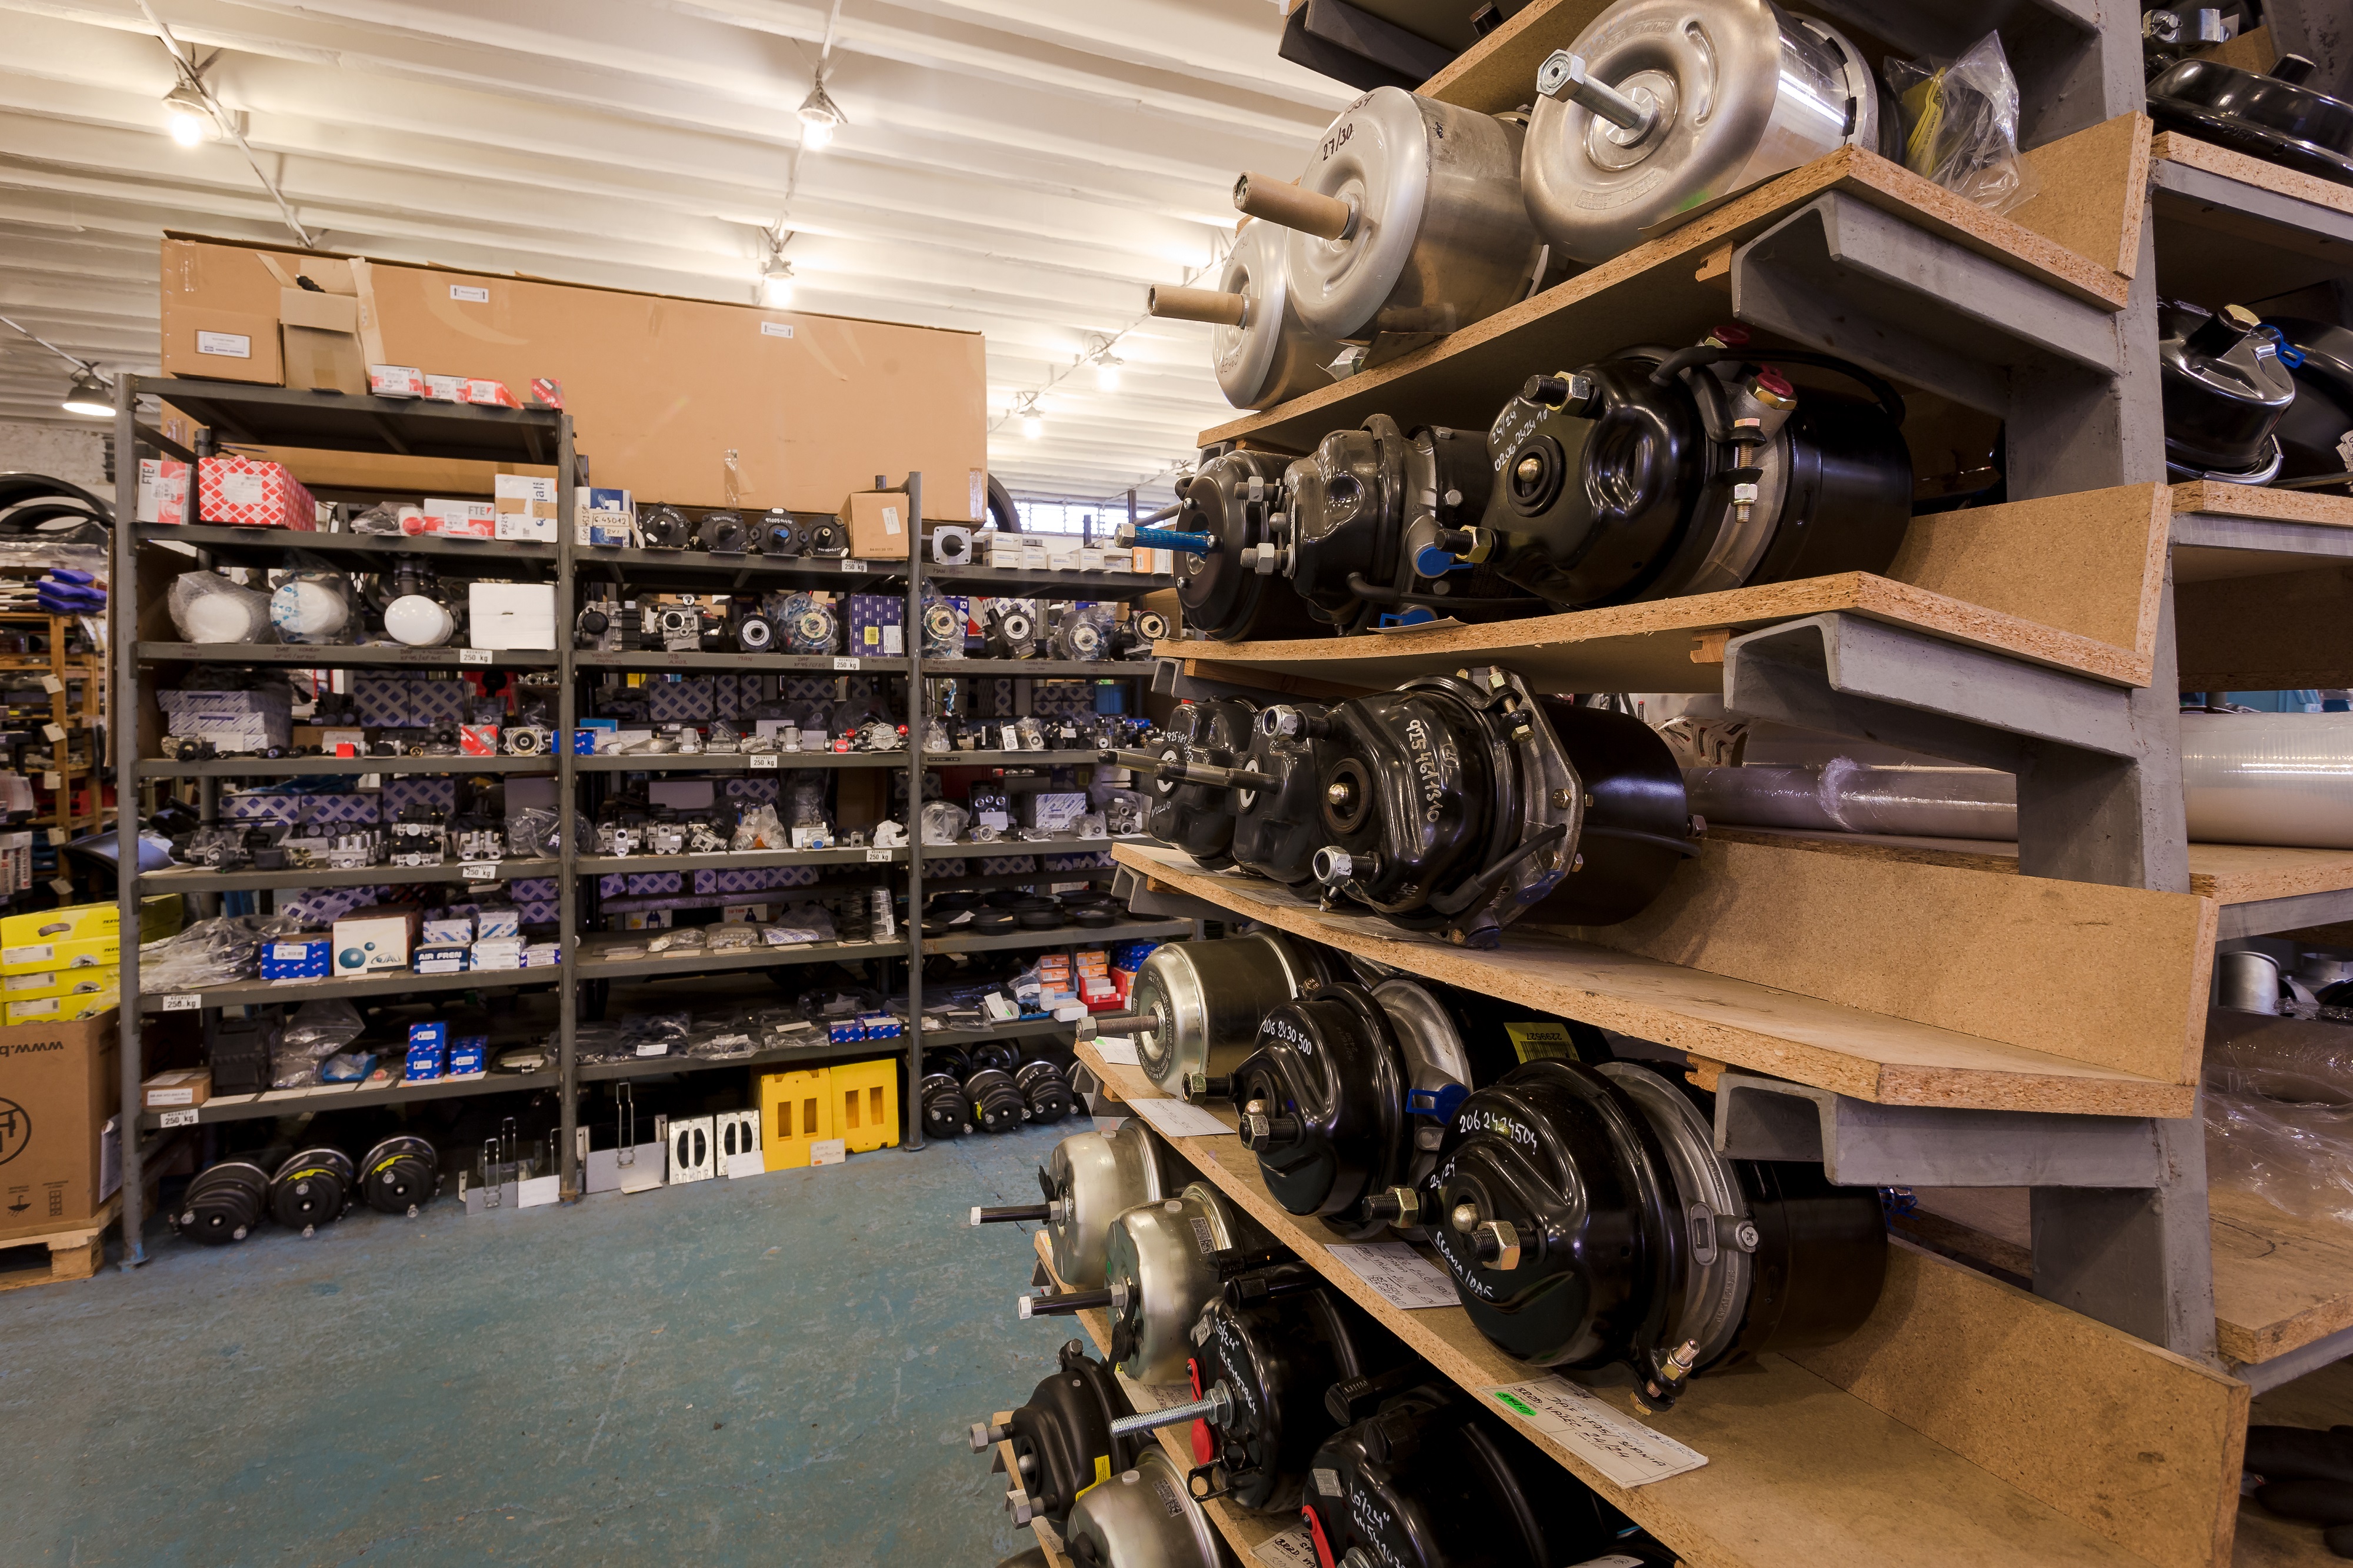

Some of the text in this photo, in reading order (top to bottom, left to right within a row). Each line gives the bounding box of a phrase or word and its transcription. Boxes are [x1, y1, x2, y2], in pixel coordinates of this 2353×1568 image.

[1323, 122, 1354, 161] 27/30
[1494, 442, 1516, 472] 0206
[1515, 419, 1537, 445] 2424
[141, 468, 155, 485] FTE
[468, 506, 485, 515] FTE
[1405, 719, 1427, 750] 925
[1415, 752, 1440, 780] 461
[1151, 800, 1171, 818] VOLVO
[483, 870, 491, 878] kg
[436, 951, 462, 960] FREN
[186, 1000, 196, 1009] kg
[1277, 1023, 1297, 1043] 2430
[1298, 1033, 1312, 1055] 500
[1526, 1032, 1563, 1042] 2299527
[165, 1116, 179, 1125] 250
[1459, 1109, 1481, 1134] 206
[1429, 1156, 1457, 1190] 24/24
[1545, 1396, 1578, 1413] DAF
